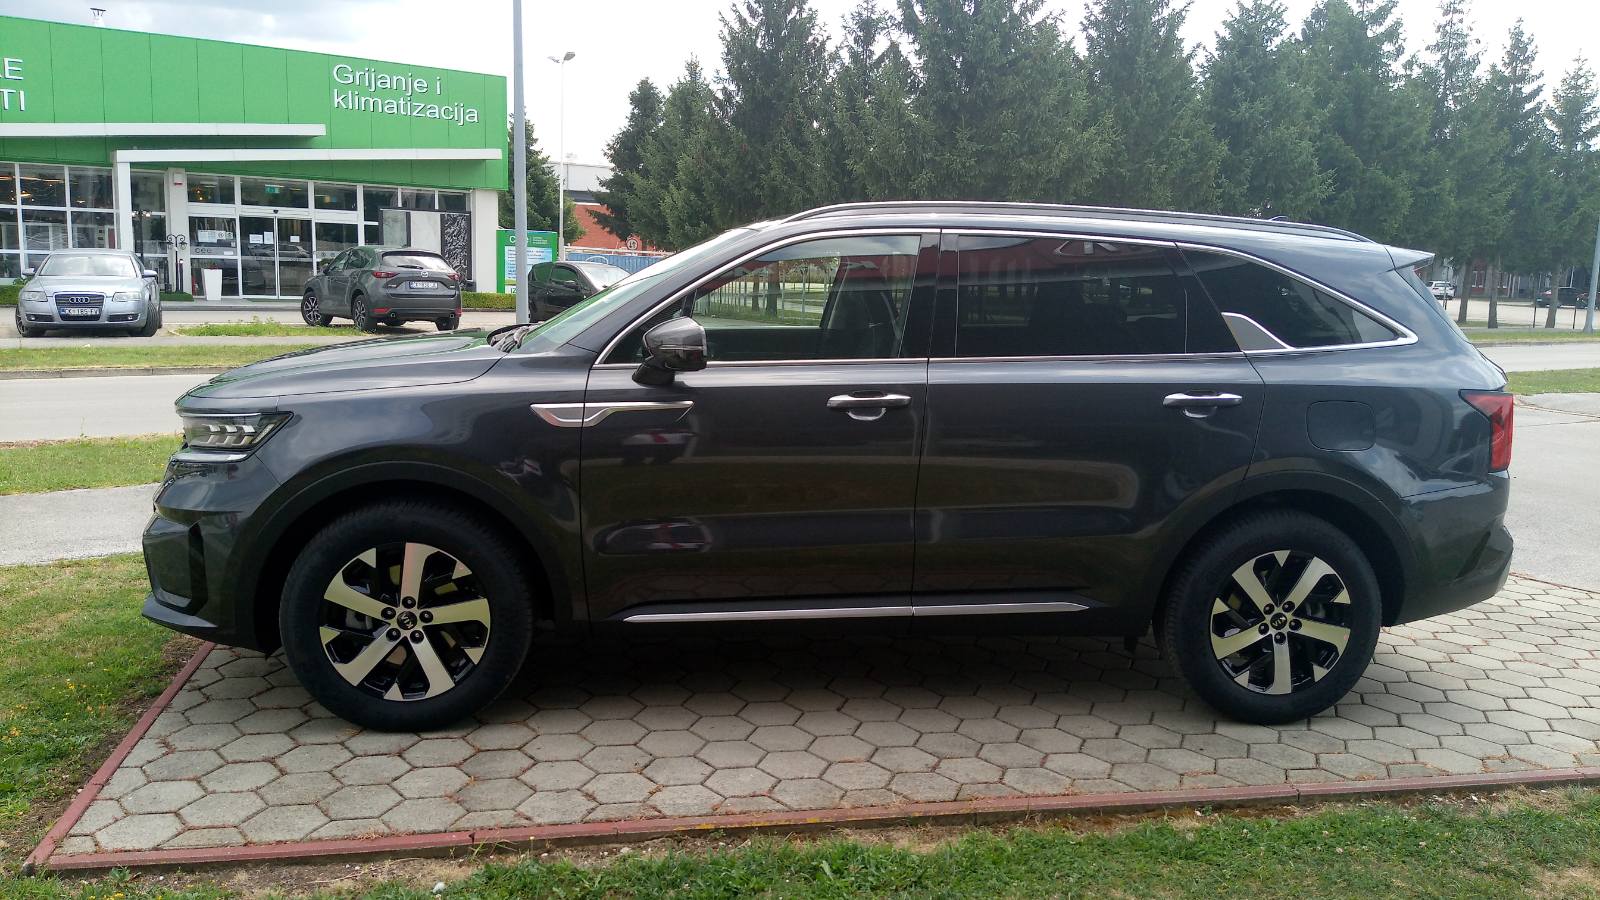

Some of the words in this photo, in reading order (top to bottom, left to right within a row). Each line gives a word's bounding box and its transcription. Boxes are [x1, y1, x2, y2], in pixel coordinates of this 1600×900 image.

[0, 57, 24, 80] E
[333, 64, 429, 96] Grijanje
[436, 76, 442, 95] i
[333, 88, 480, 126] klimatizacija
